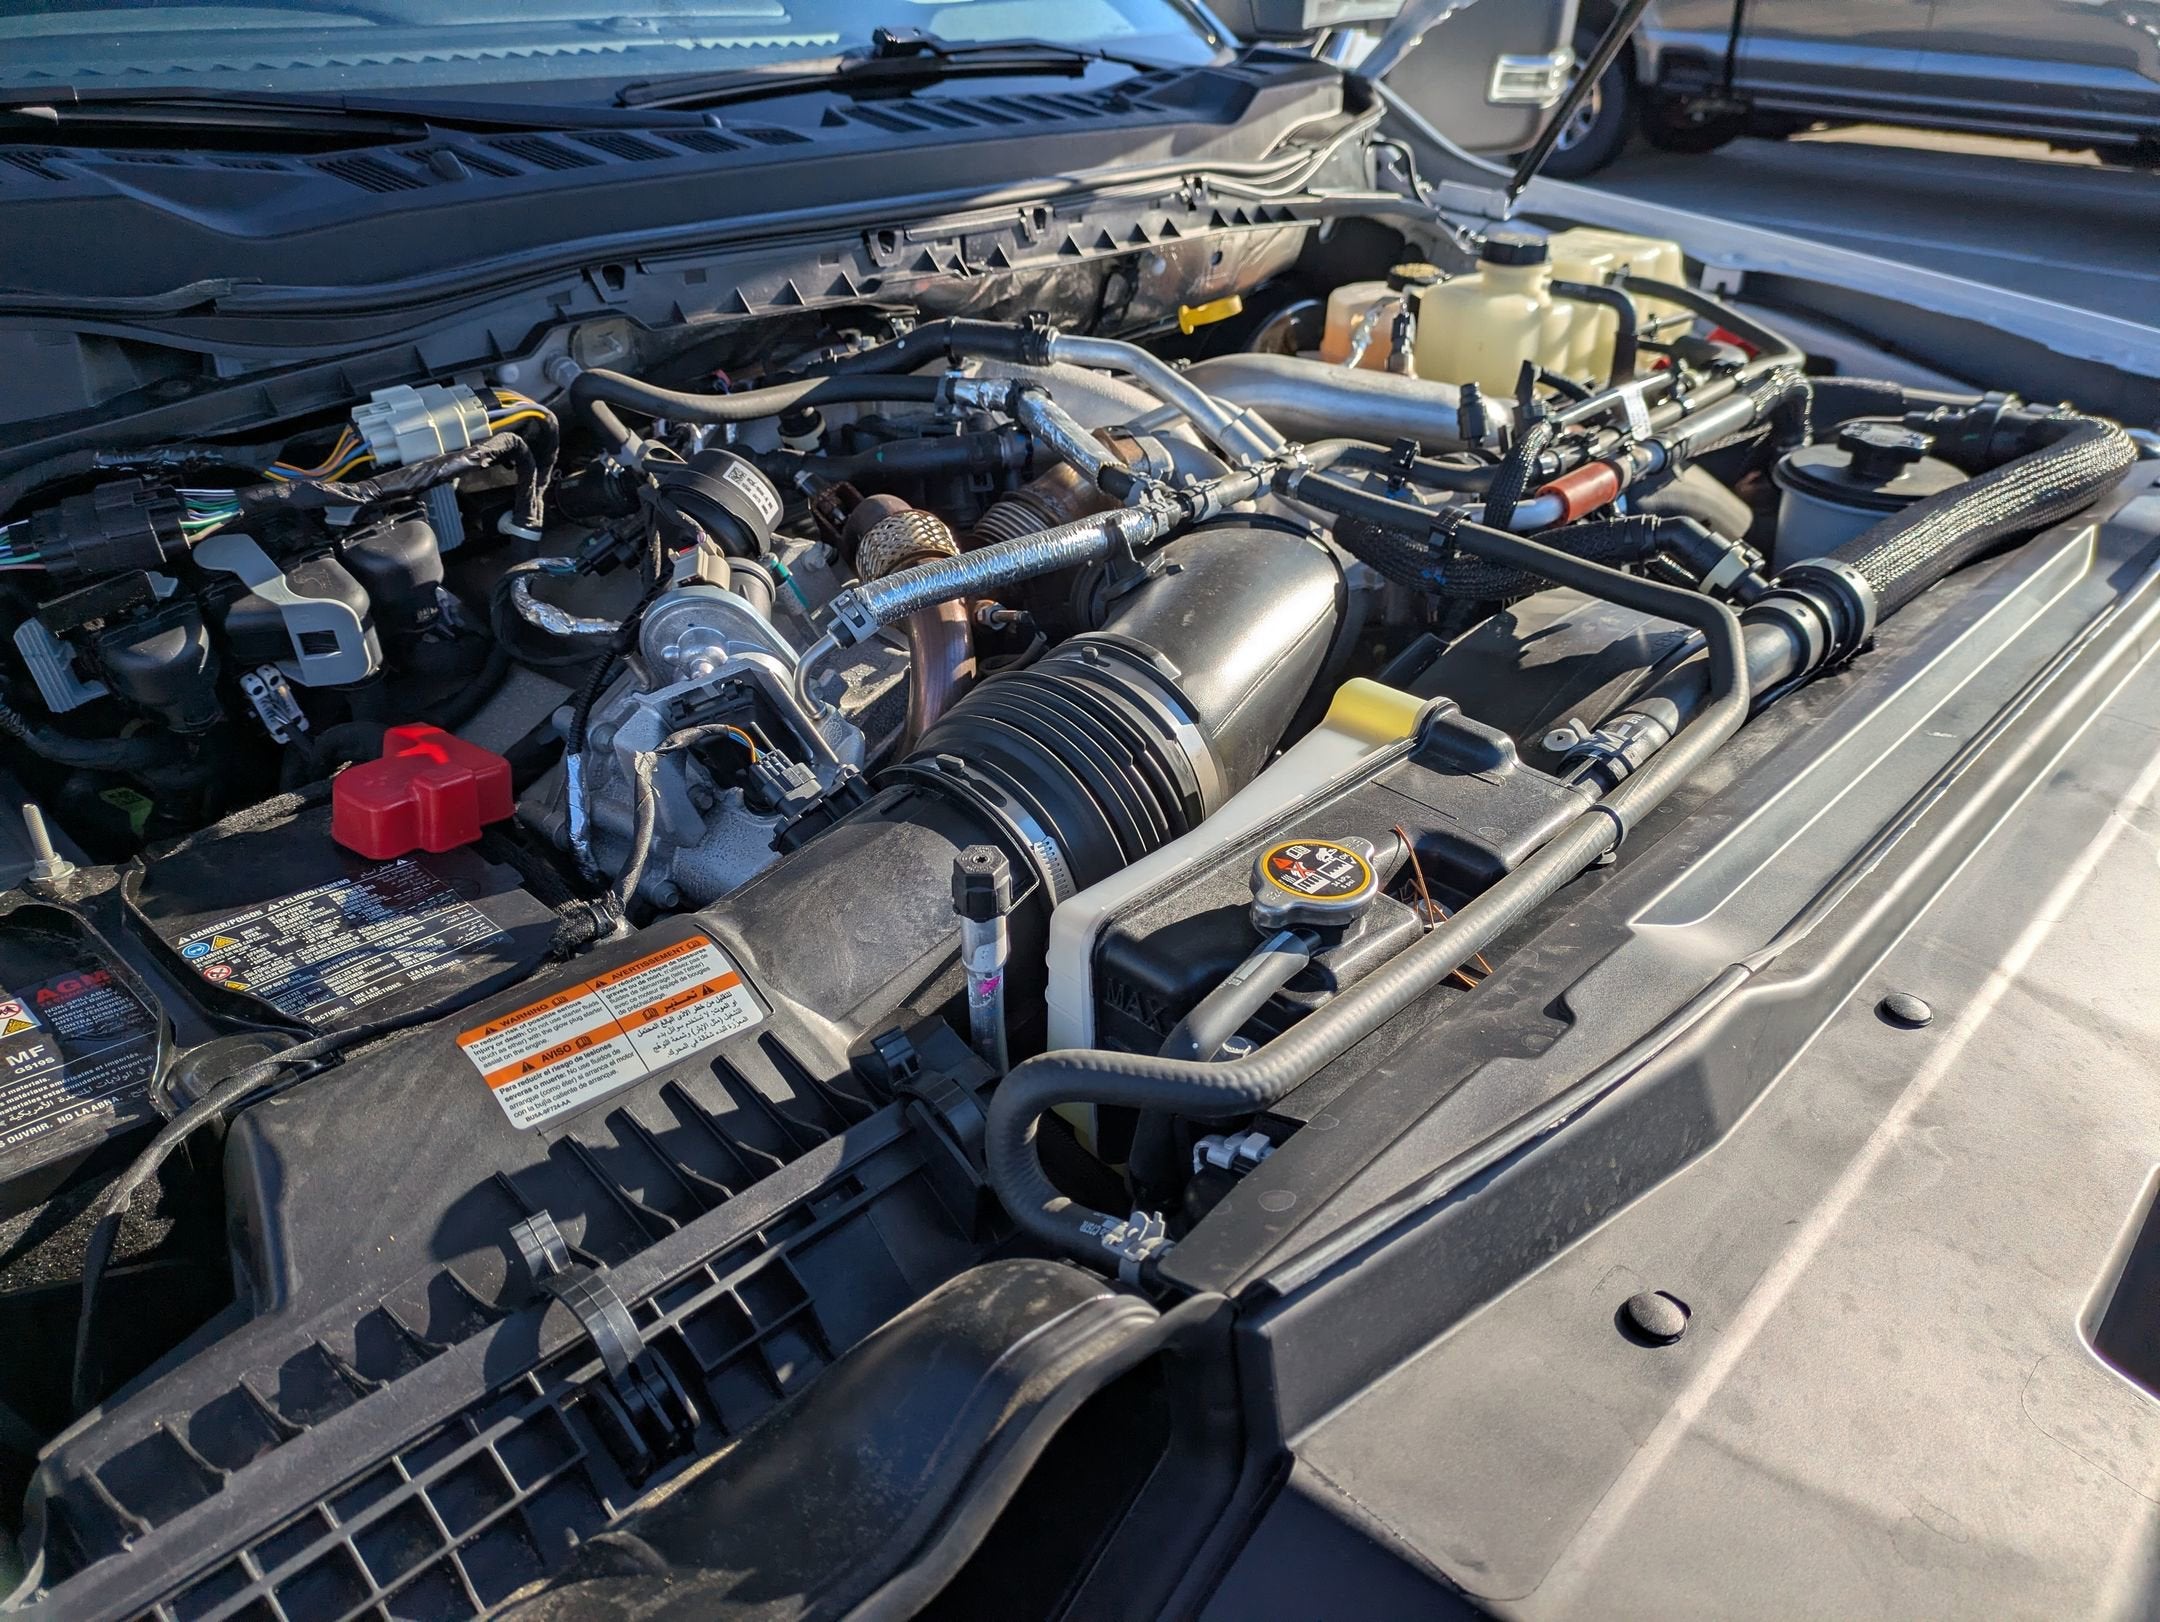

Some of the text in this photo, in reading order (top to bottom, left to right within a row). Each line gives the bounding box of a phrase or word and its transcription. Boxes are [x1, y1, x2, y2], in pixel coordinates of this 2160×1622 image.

[278, 879, 351, 906] PELIGRO/VENENO
[189, 910, 264, 939] DANGER/POISON
[612, 946, 684, 980] AVERTISSEMENT
[478, 1051, 498, 1062] (such
[507, 1038, 527, 1049] ether)
[527, 1032, 542, 1041] with
[553, 1021, 568, 1031] glow
[568, 1015, 584, 1025] plug
[583, 1006, 603, 1018] starter
[480, 1033, 504, 1046] reduce
[505, 1027, 518, 1035] risk
[527, 1011, 556, 1027] possible
[557, 1001, 582, 1013] serious
[500, 1004, 549, 1027] WARNING
[504, 1031, 527, 1043] death:
[538, 1021, 549, 1029] not
[562, 1008, 582, 1019] starter
[582, 1001, 599, 1010] fluids
[5, 1044, 47, 1067] MF
[483, 1057, 503, 1068] assist
[513, 1048, 525, 1056] the
[525, 1038, 549, 1051] engine.
[499, 1043, 612, 1095] Para reducir el riesgo de lesiones
[541, 1044, 572, 1062] AVISO
[8, 1077, 50, 1095] materials.
[505, 1087, 533, 1102] severas
[539, 1072, 566, 1087] muerte:
[566, 1067, 578, 1075] No
[577, 1062, 590, 1070] use
[590, 1053, 612, 1065] fluidos
[611, 1048, 621, 1056] de
[509, 1094, 540, 1111] arranque
[539, 1084, 561, 1097] (como
[561, 1077, 577, 1087] éter)
[584, 1064, 609, 1077] arranca
[616, 1051, 634, 1063] motor
[513, 1109, 527, 1118] con
[552, 1086, 578, 1101] caliente
[588, 1069, 617, 1085] arranque.
[8, 1096, 121, 1143] OUVRIR. NO LA ABRA.
